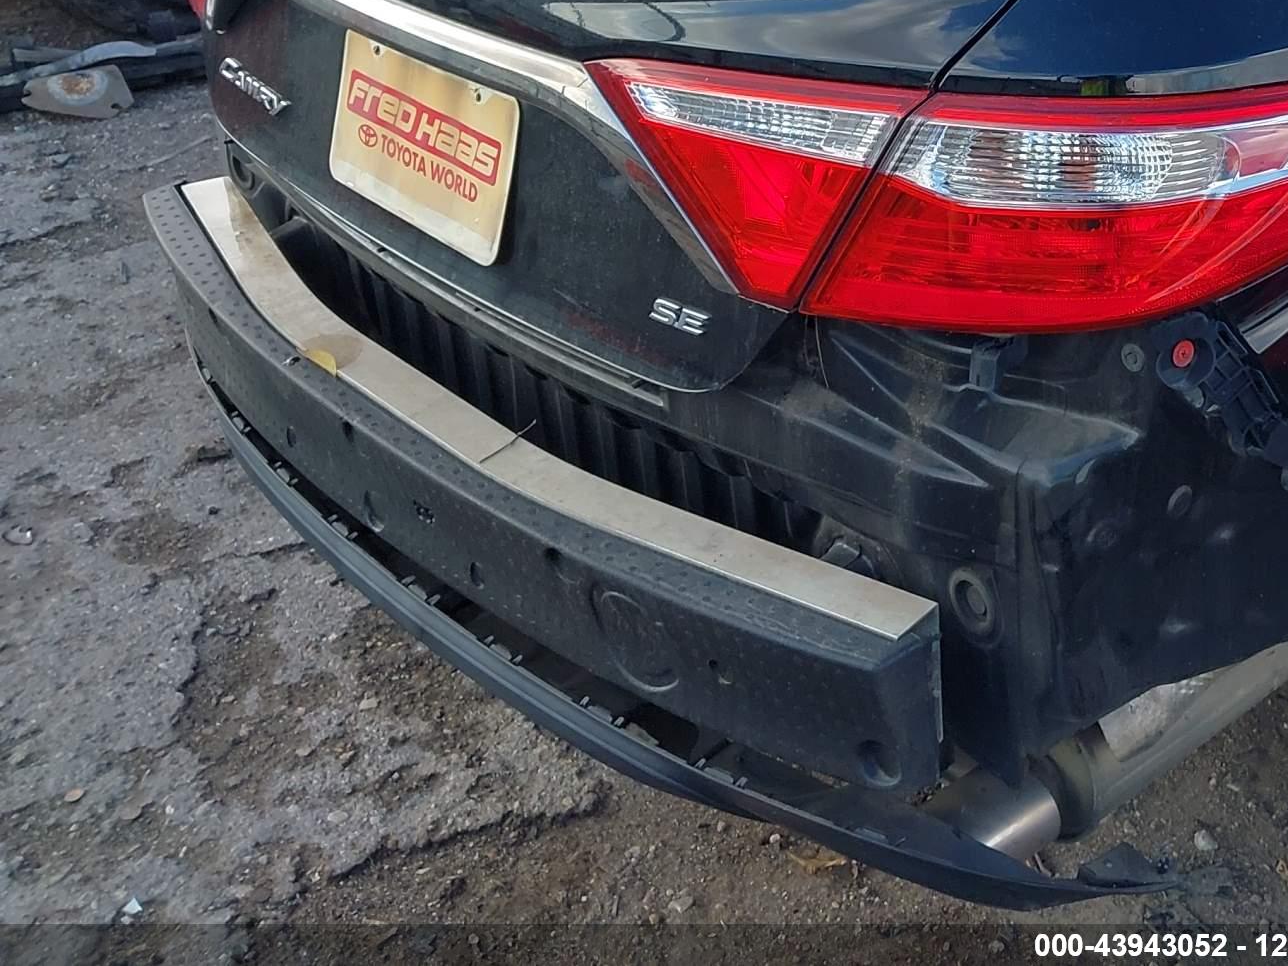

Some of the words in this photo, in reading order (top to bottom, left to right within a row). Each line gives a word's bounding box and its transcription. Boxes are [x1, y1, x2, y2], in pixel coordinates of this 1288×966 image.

[381, 134, 427, 177] TOYOTA
[430, 160, 479, 203] WORLD
[649, 297, 712, 335] SE
